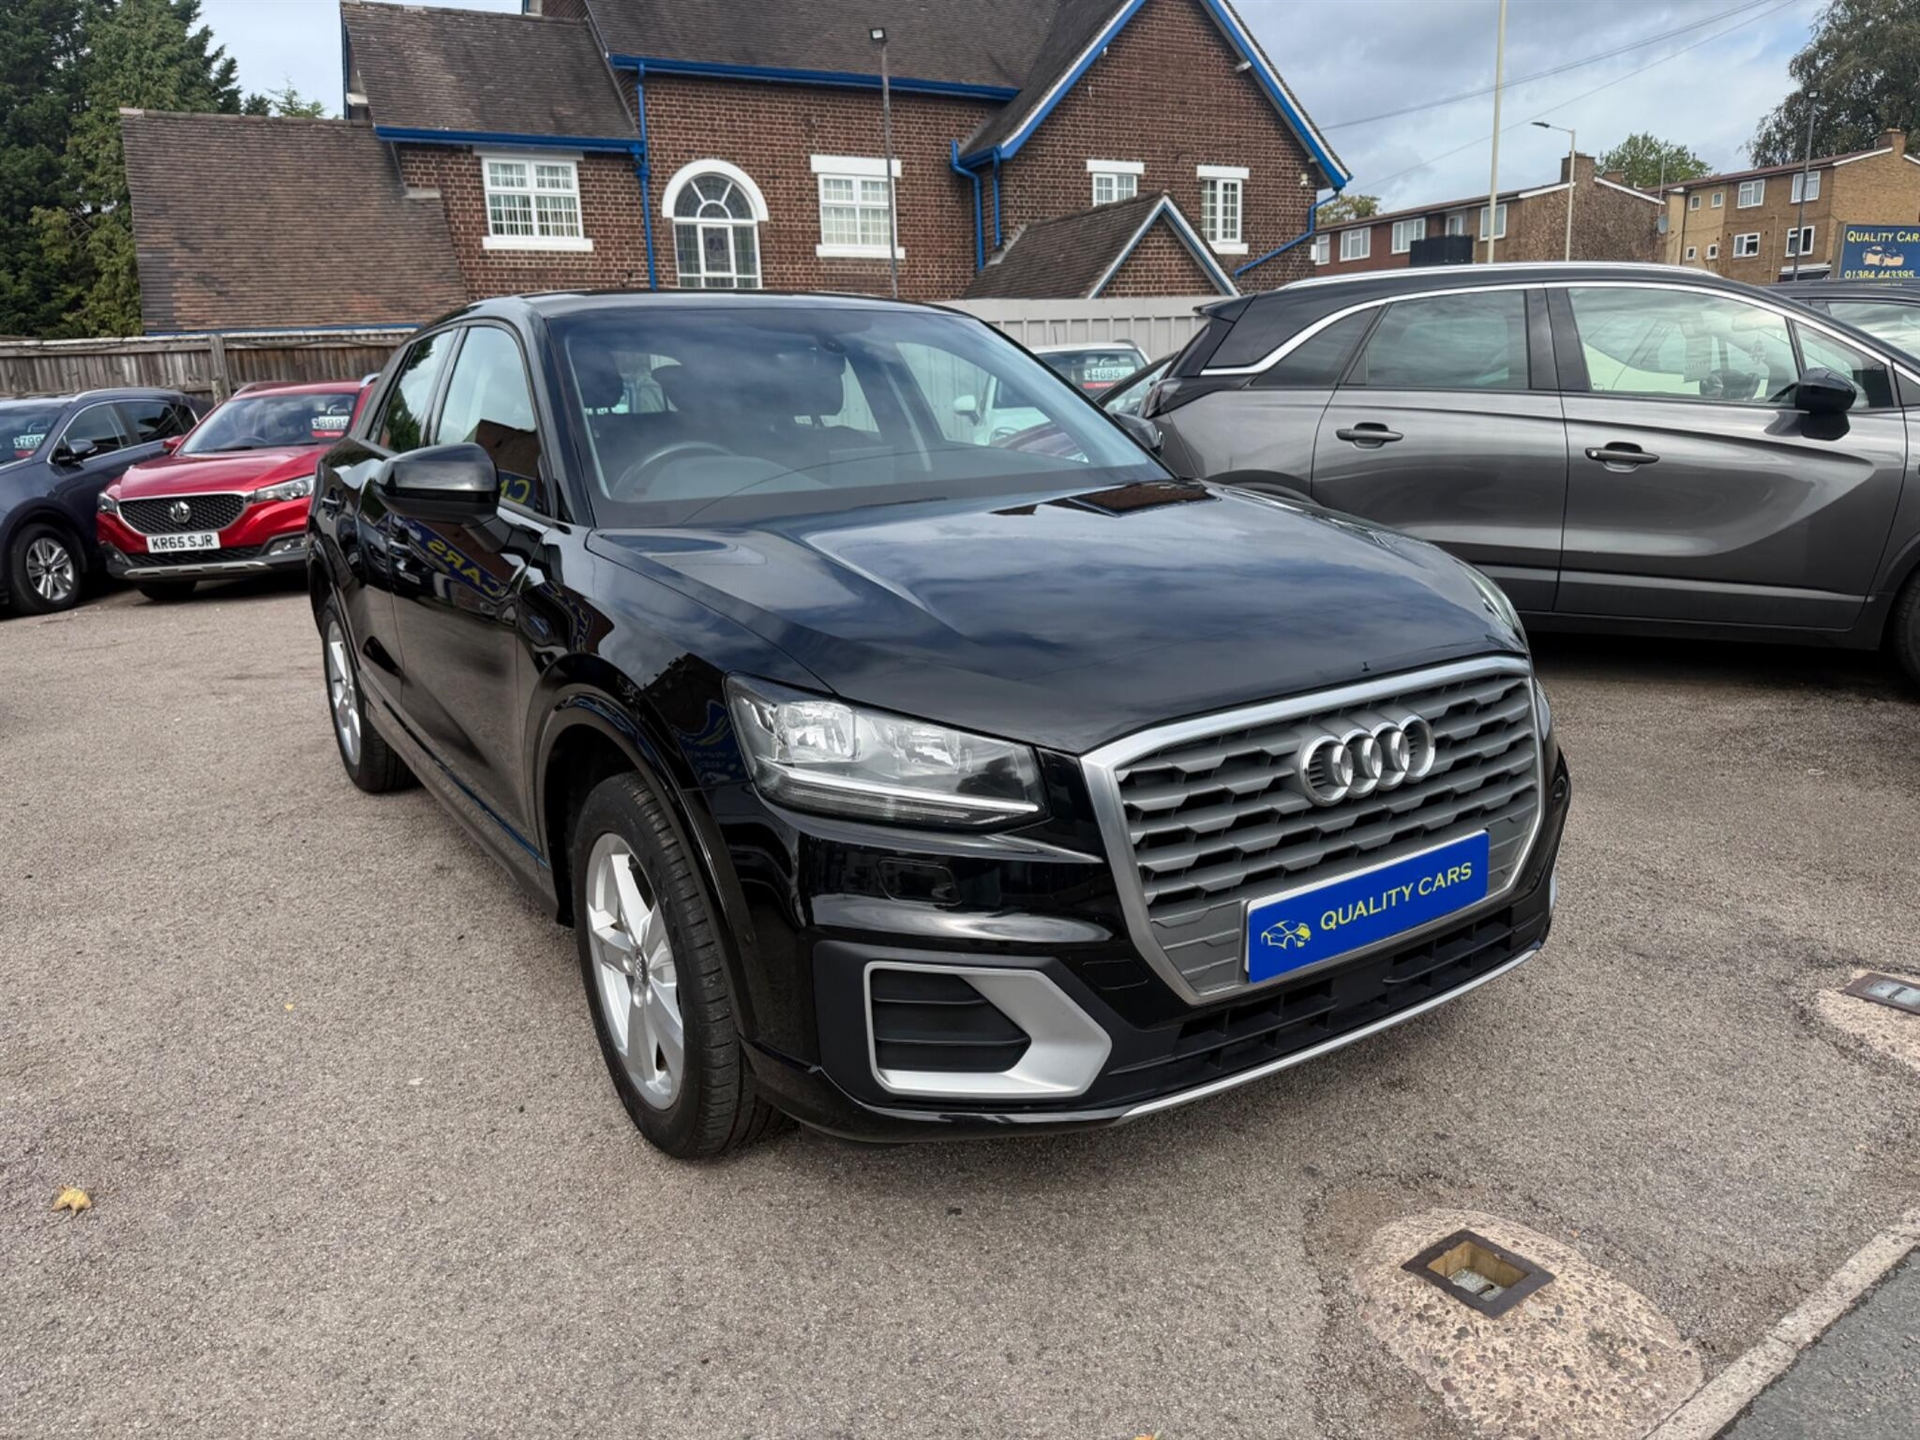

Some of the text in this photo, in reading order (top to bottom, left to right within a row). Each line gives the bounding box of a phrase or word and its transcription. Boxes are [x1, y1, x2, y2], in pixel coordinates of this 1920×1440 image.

[1847, 231, 1920, 243] QUALITY CAR
[1844, 270, 1875, 279] 01384
[151, 534, 214, 550] KR65 SJR
[1320, 862, 1472, 931] QUALITY CARS
